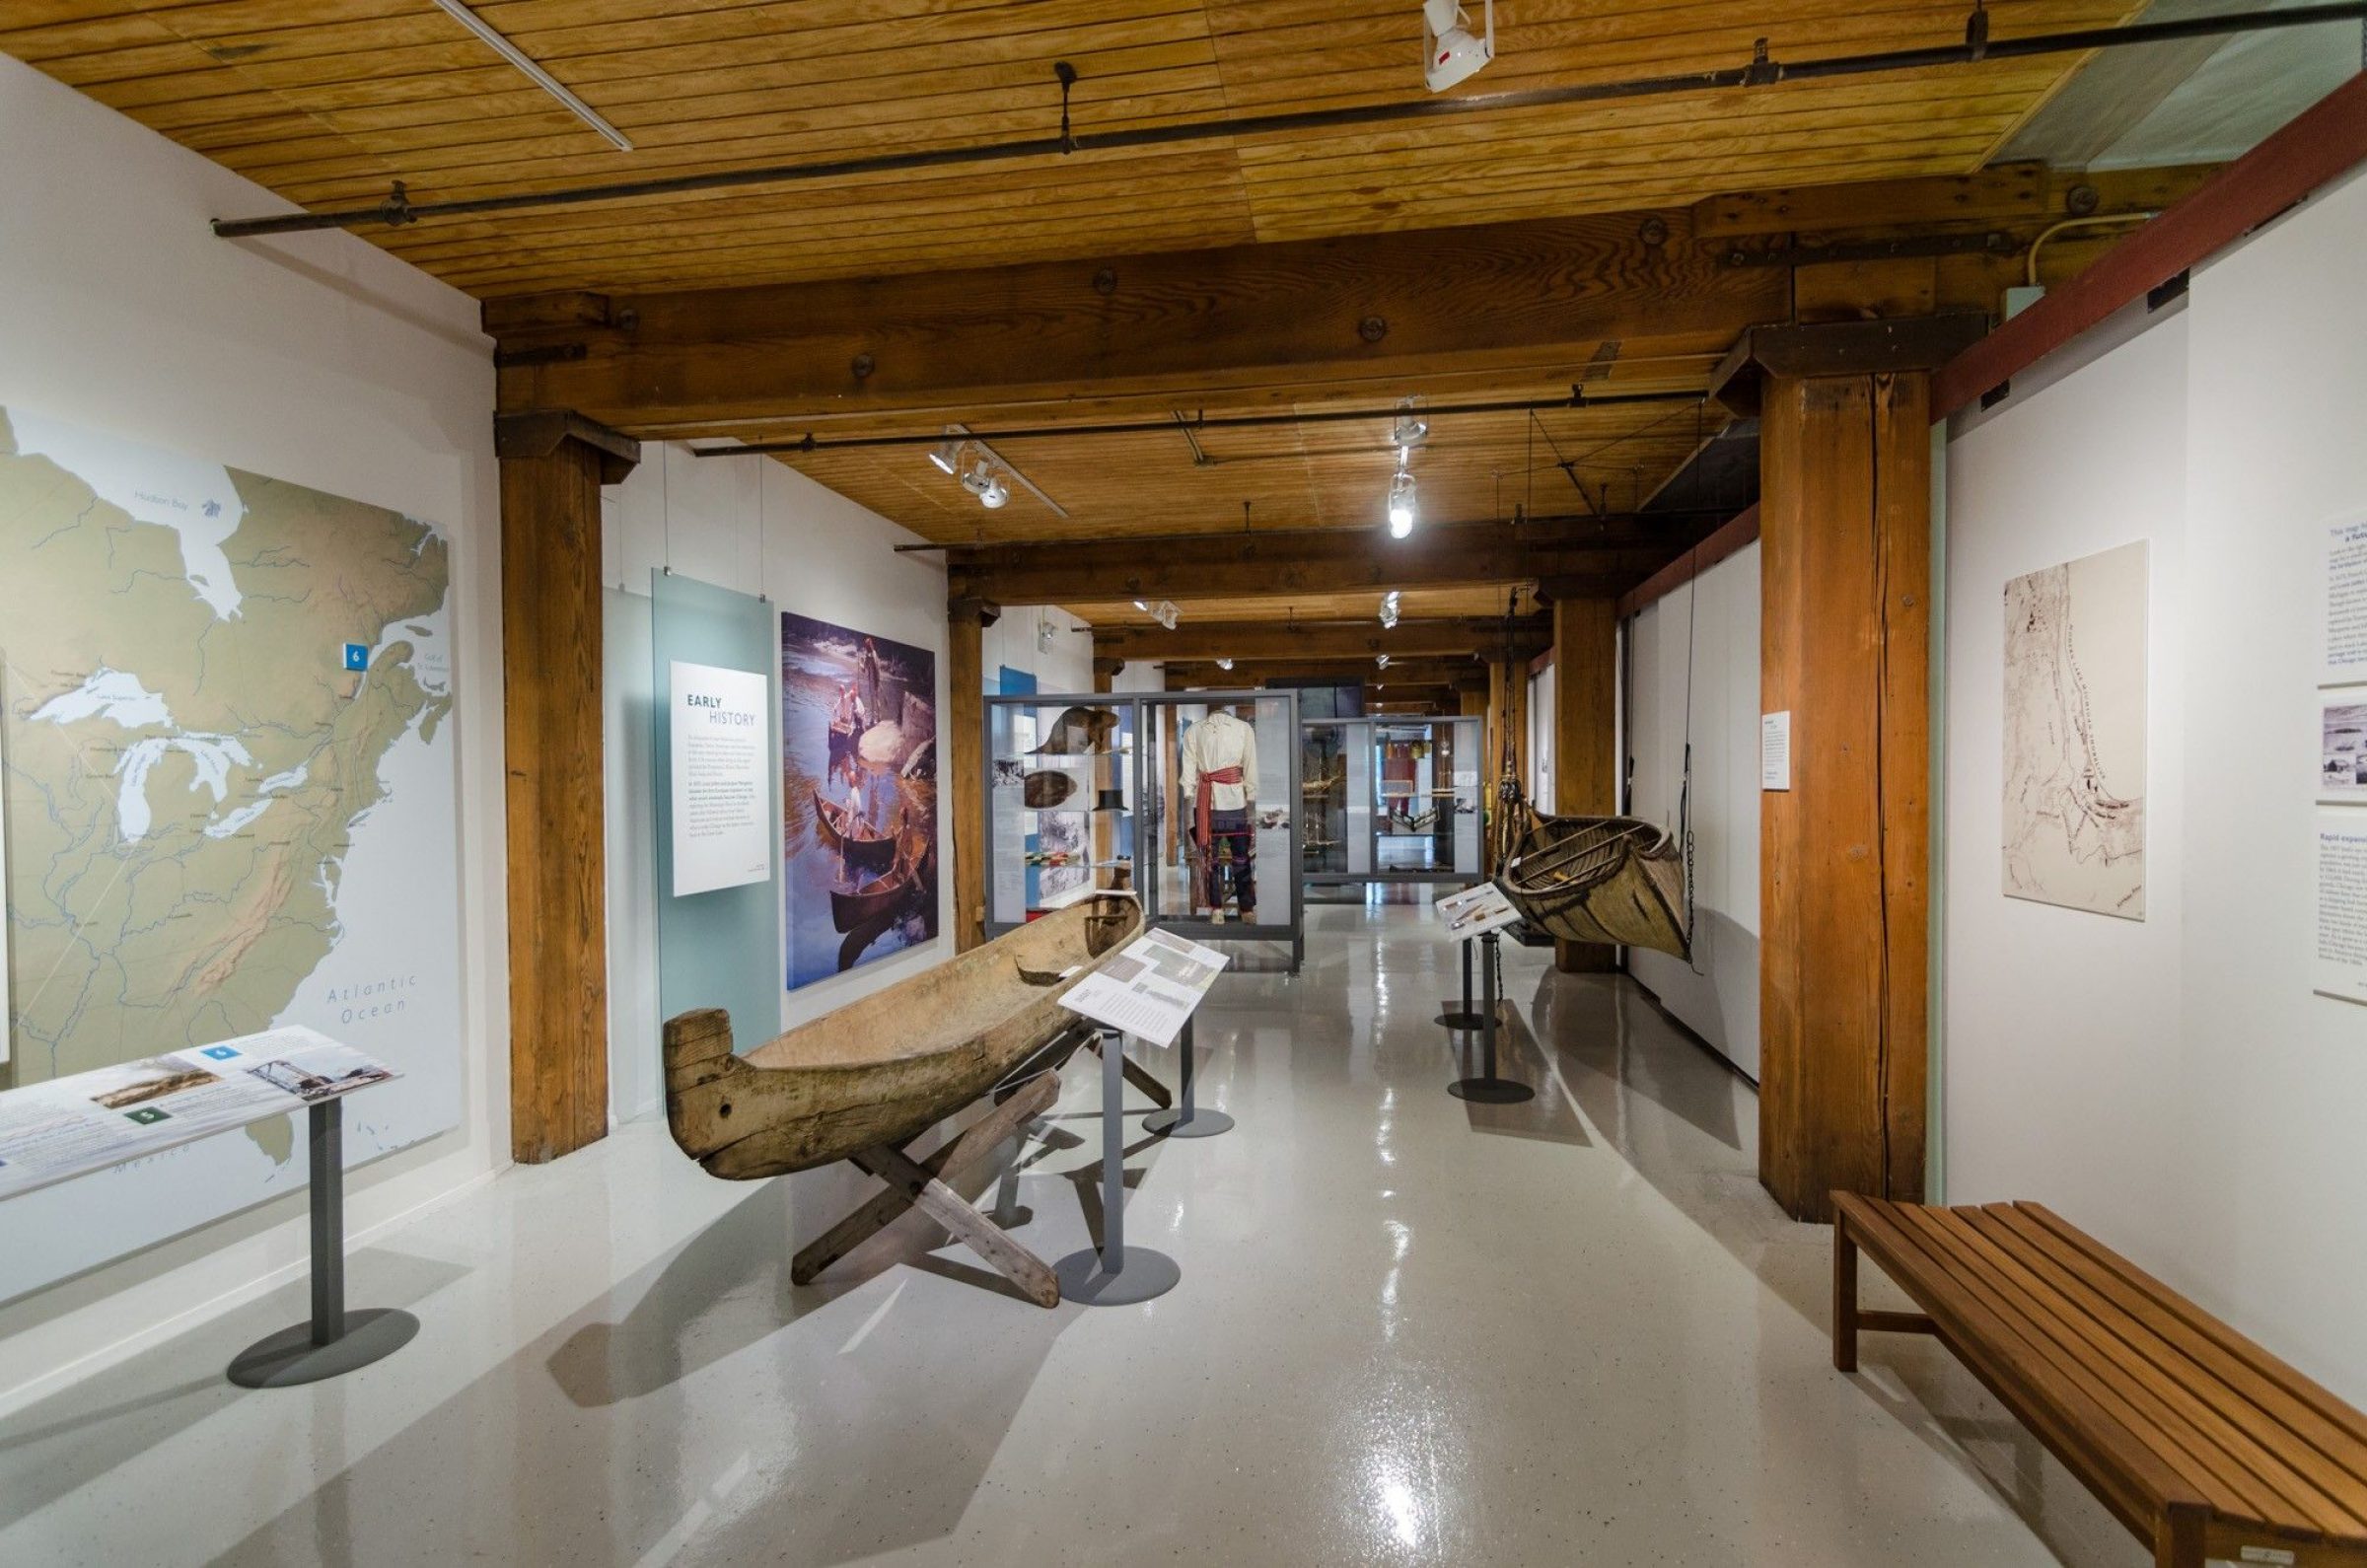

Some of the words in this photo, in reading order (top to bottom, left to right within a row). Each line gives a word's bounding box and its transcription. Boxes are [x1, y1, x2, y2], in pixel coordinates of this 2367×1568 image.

[352, 650, 361, 663] 6
[687, 693, 722, 709] EARLY
[709, 710, 755, 727] HISTORY
[326, 974, 416, 1003] Atlantic
[341, 999, 405, 1025] Ocean
